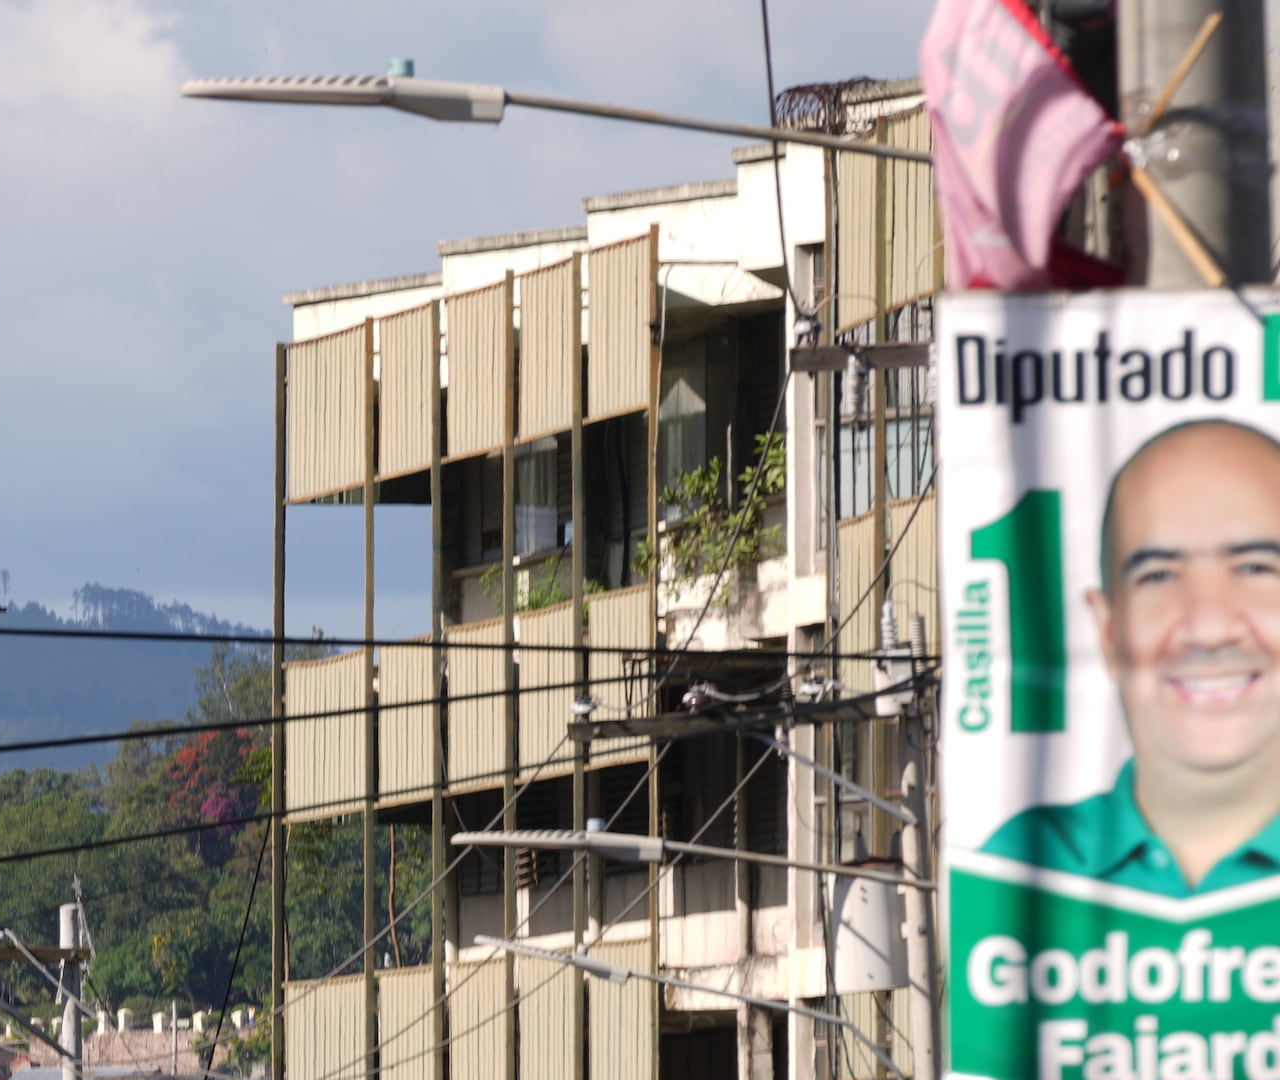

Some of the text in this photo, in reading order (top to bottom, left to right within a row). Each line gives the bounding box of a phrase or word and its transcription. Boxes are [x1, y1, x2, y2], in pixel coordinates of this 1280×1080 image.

[956, 328, 1236, 424] Diputado
[957, 579, 991, 733] Casilla
[969, 488, 1066, 735] 1
